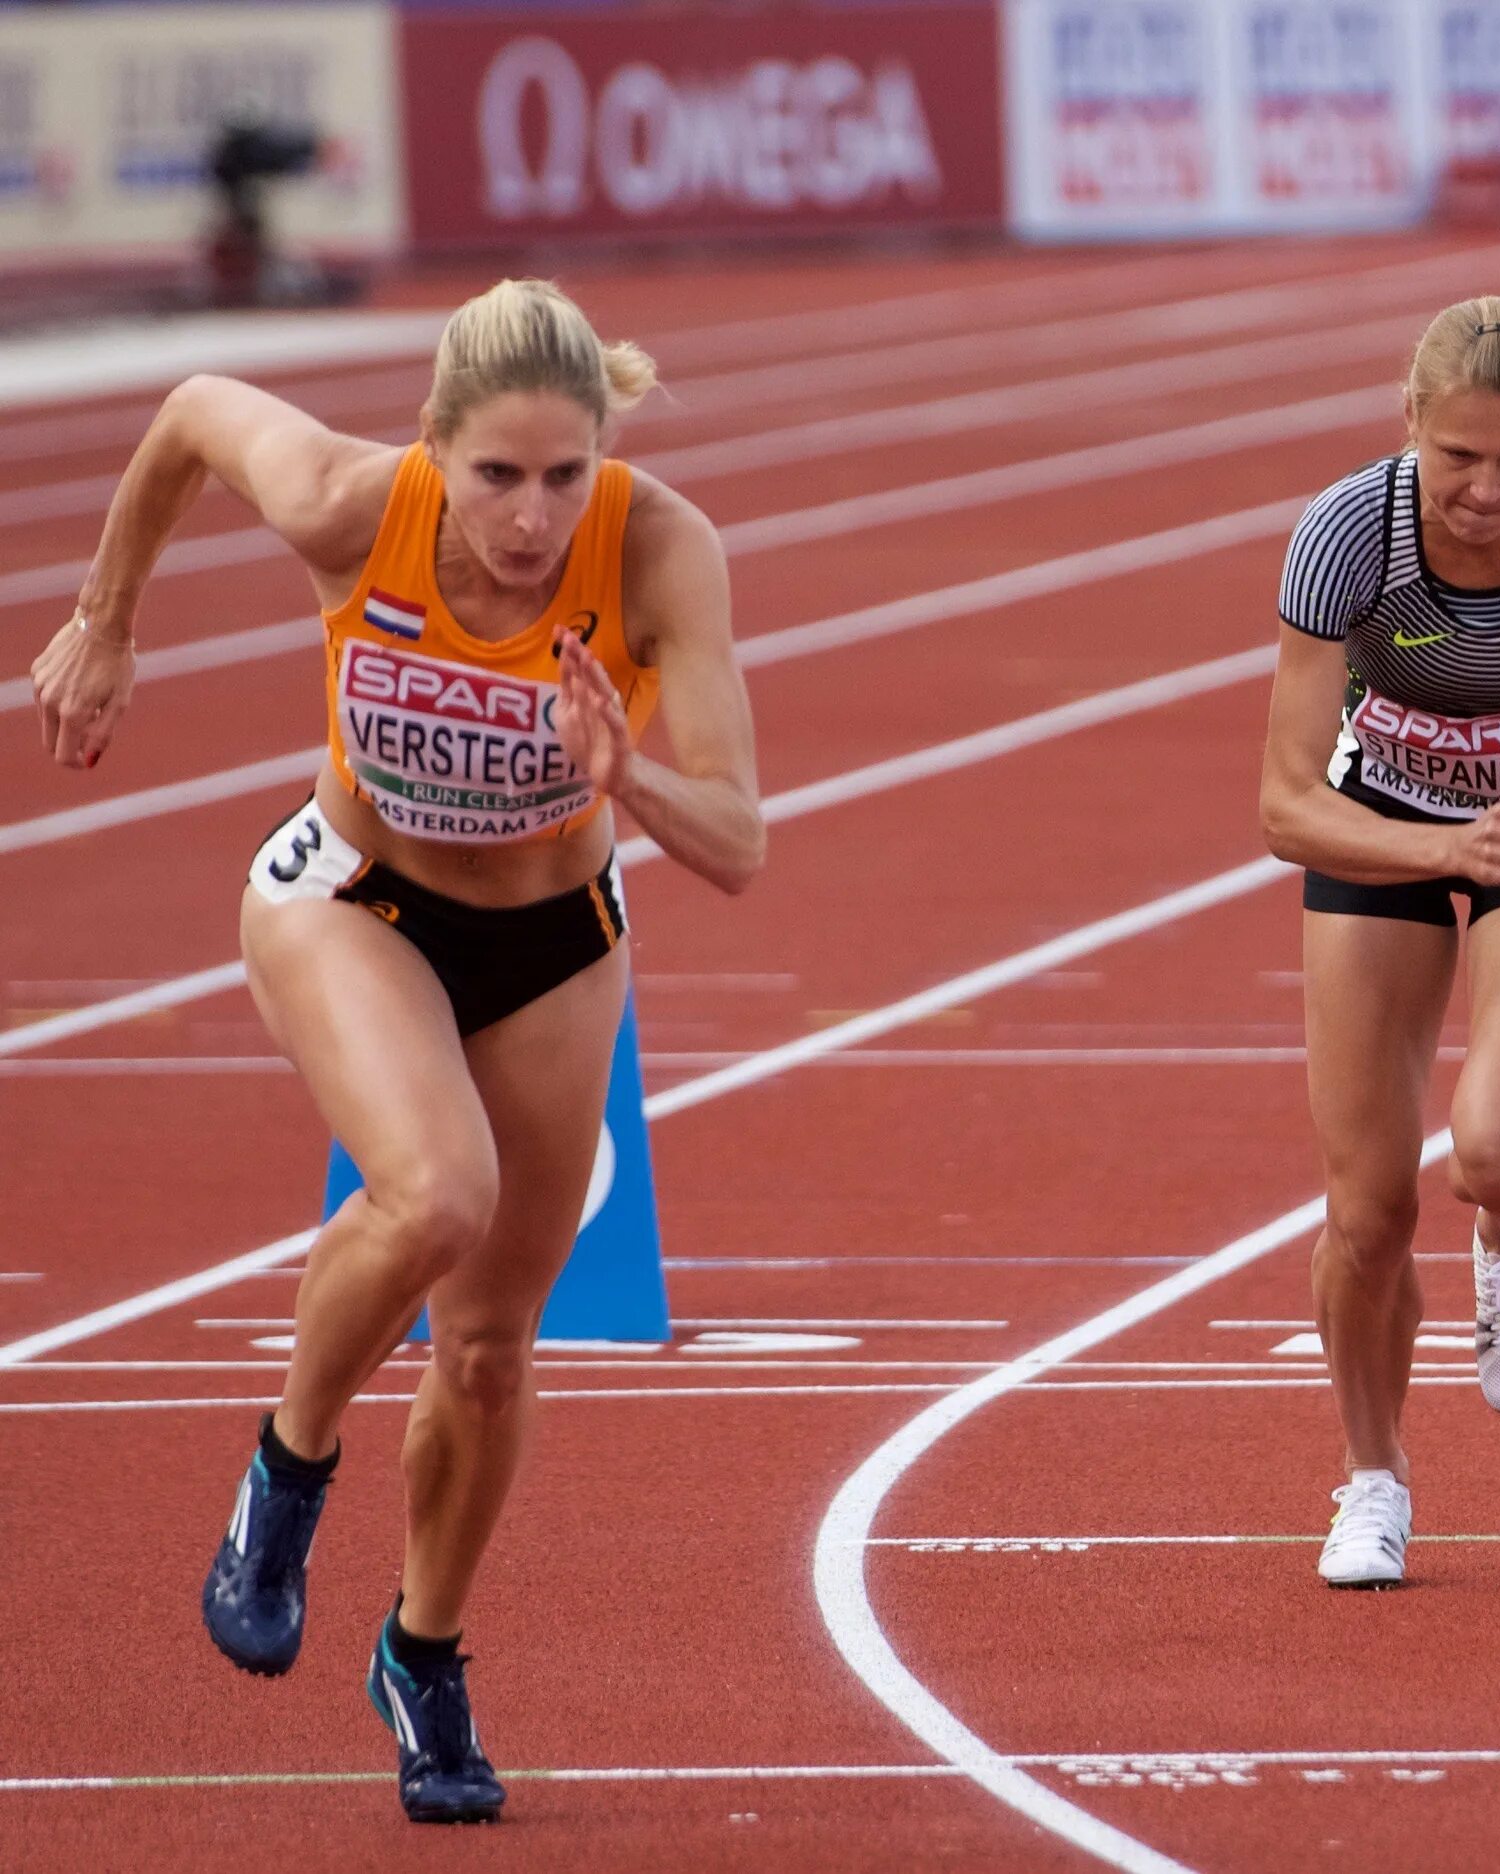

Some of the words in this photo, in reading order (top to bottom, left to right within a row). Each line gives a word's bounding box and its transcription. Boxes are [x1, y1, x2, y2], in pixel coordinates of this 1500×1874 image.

[602, 60, 942, 212] OMEGA
[352, 653, 532, 728] SPAR
[348, 705, 577, 787] VERSTEGE
[413, 782, 460, 806] RUN
[268, 818, 322, 883] 3
